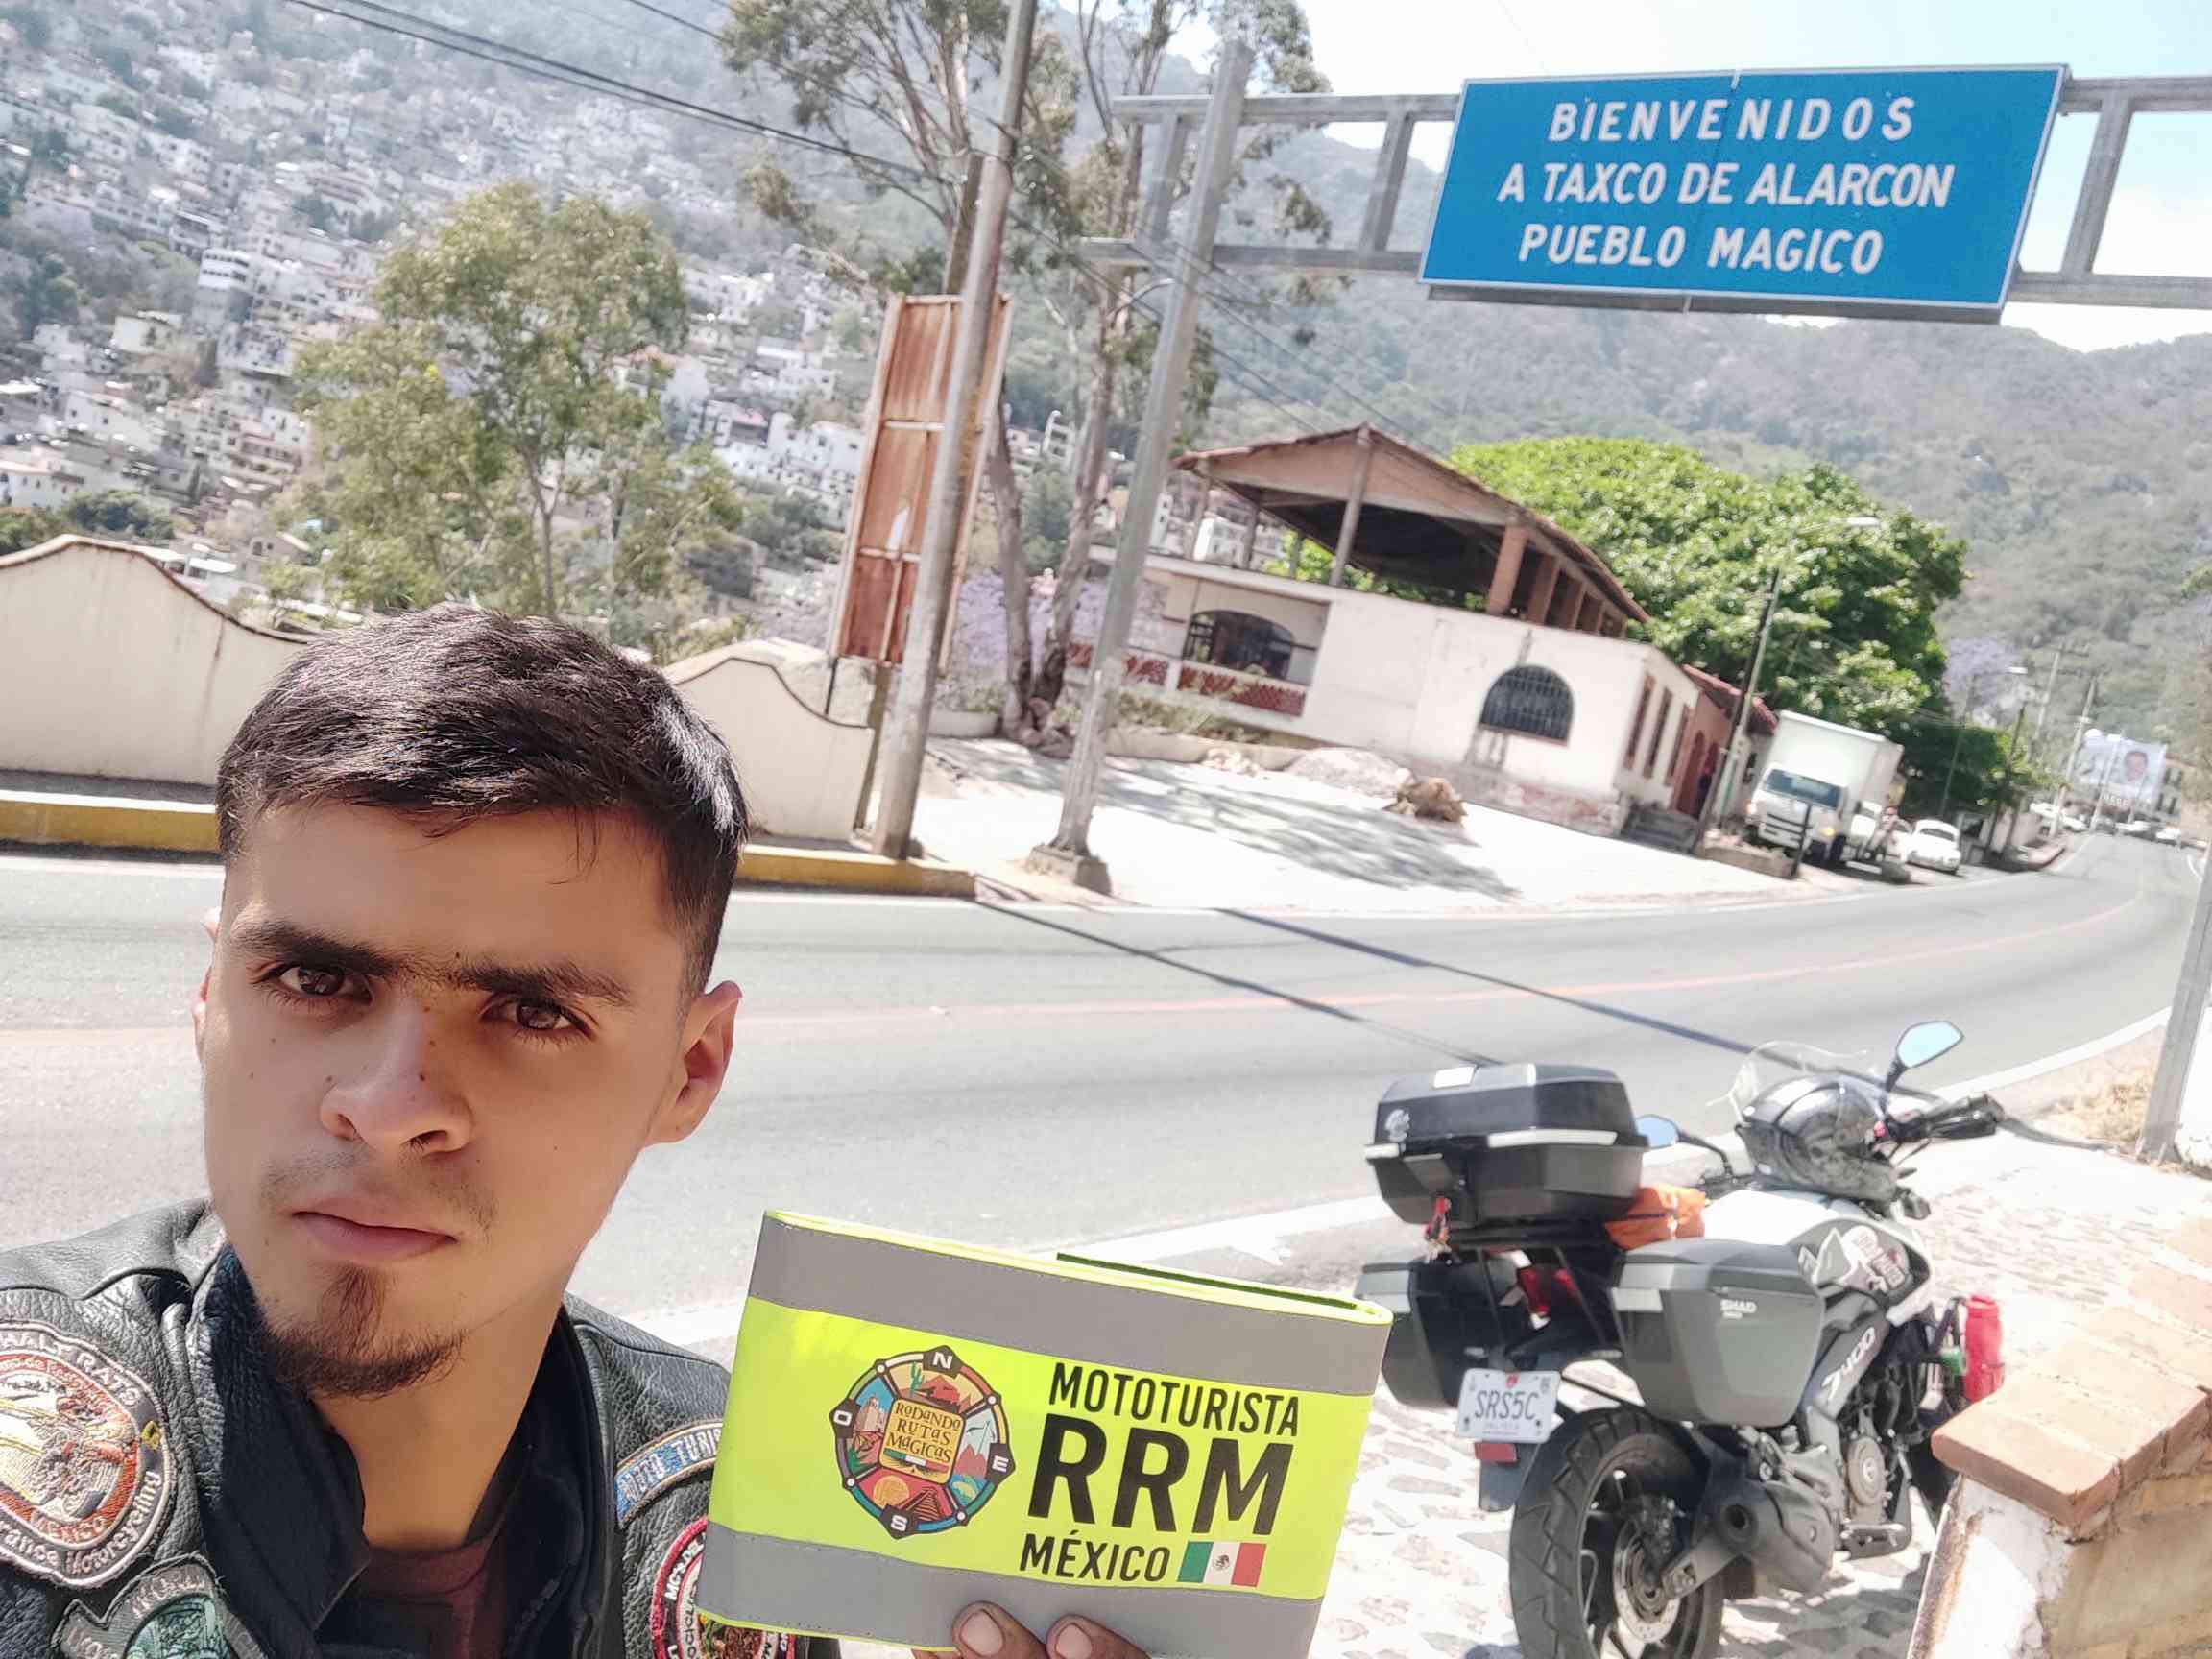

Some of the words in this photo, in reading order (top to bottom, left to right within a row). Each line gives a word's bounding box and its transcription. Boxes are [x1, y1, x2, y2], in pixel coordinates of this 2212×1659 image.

[1548, 96, 1915, 143] BIENVENIDOS
[1497, 162, 1526, 203] A
[1543, 161, 1668, 204] TAXCO
[1676, 162, 1734, 205] DE
[1744, 163, 1956, 208] ALARCON
[1518, 222, 1686, 269] PUEBLO
[1706, 226, 1884, 275] MAGICO
[932, 1351, 953, 1370] N
[832, 1410, 853, 1427] O
[1048, 1362, 1300, 1438] MOTOTURISTA
[1474, 1389, 1540, 1420] SRS5C
[991, 1455, 1010, 1474] E
[1027, 1412, 1294, 1535] RRM
[890, 1514, 909, 1532] S
[1020, 1530, 1170, 1583] MÉXICO
